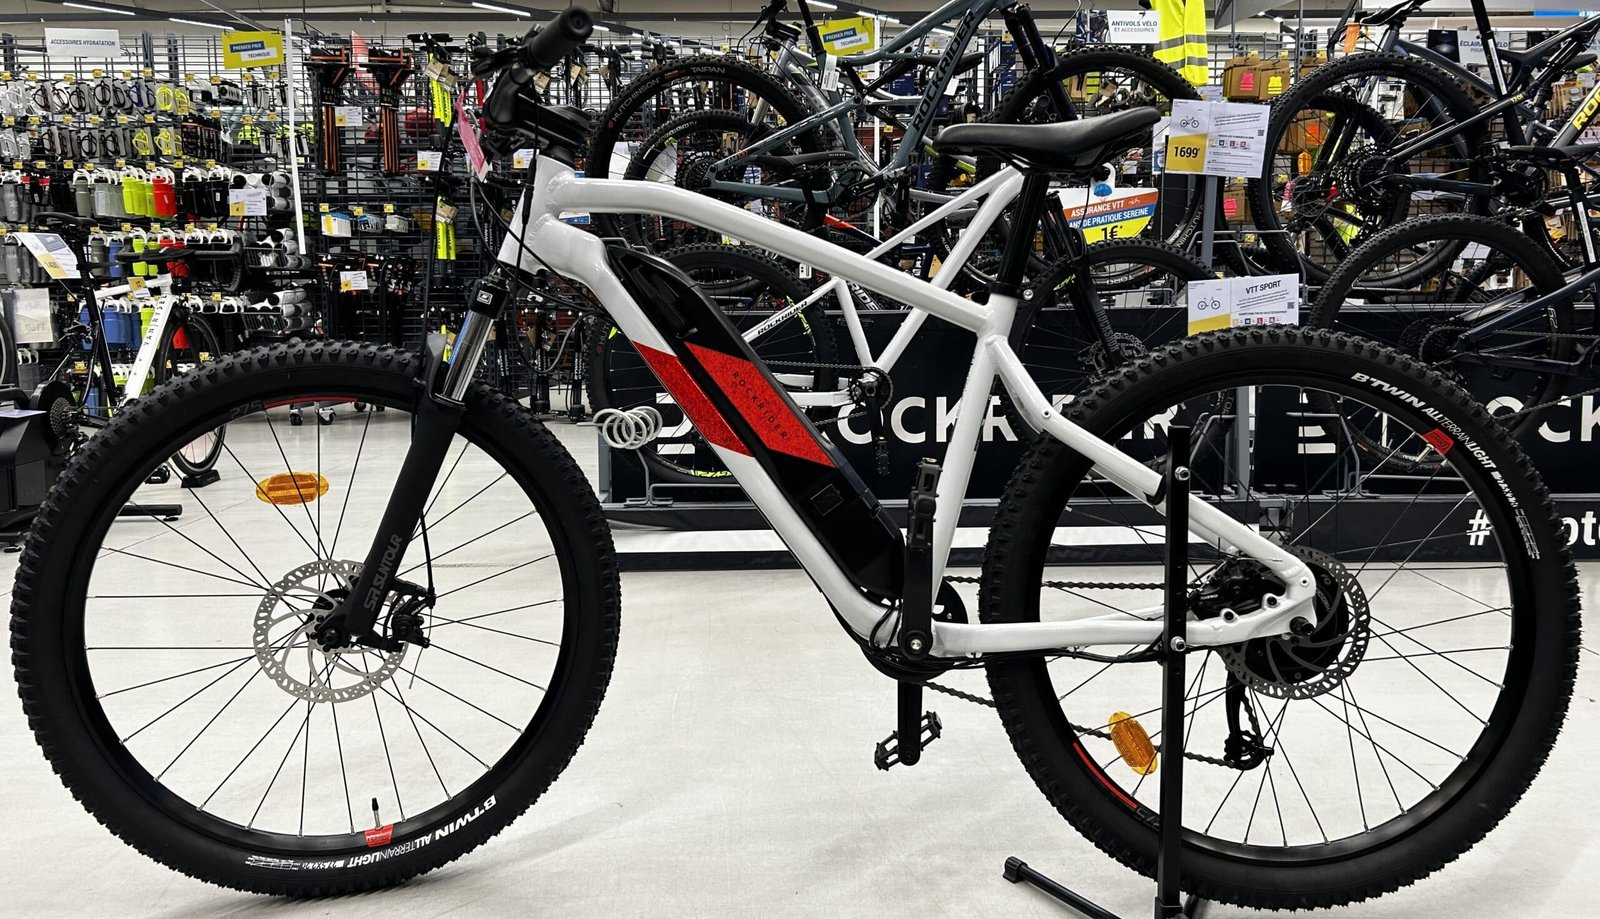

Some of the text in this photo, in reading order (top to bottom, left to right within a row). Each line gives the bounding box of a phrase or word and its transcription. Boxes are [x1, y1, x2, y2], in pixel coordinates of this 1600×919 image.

[1142, 19, 1158, 27] VÉLO
[690, 66, 726, 75] TAIPAN
[912, 9, 976, 132] ROCKRIDER
[612, 77, 661, 122] HUTCHINSON
[1173, 146, 1201, 159] 1699
[1082, 218, 1092, 227] DE
[1092, 213, 1123, 226] PRATIQUE
[1123, 206, 1149, 220] SEREINE
[1112, 200, 1125, 210] VTT
[1176, 211, 1203, 249] HUTCHIN
[1245, 279, 1282, 295] VTT SPORT
[732, 371, 788, 439] ROCKRIDER
[1350, 372, 1425, 409] B'TWIN
[373, 534, 402, 590] SUNTOUR
[435, 794, 498, 841] B'TWIN
